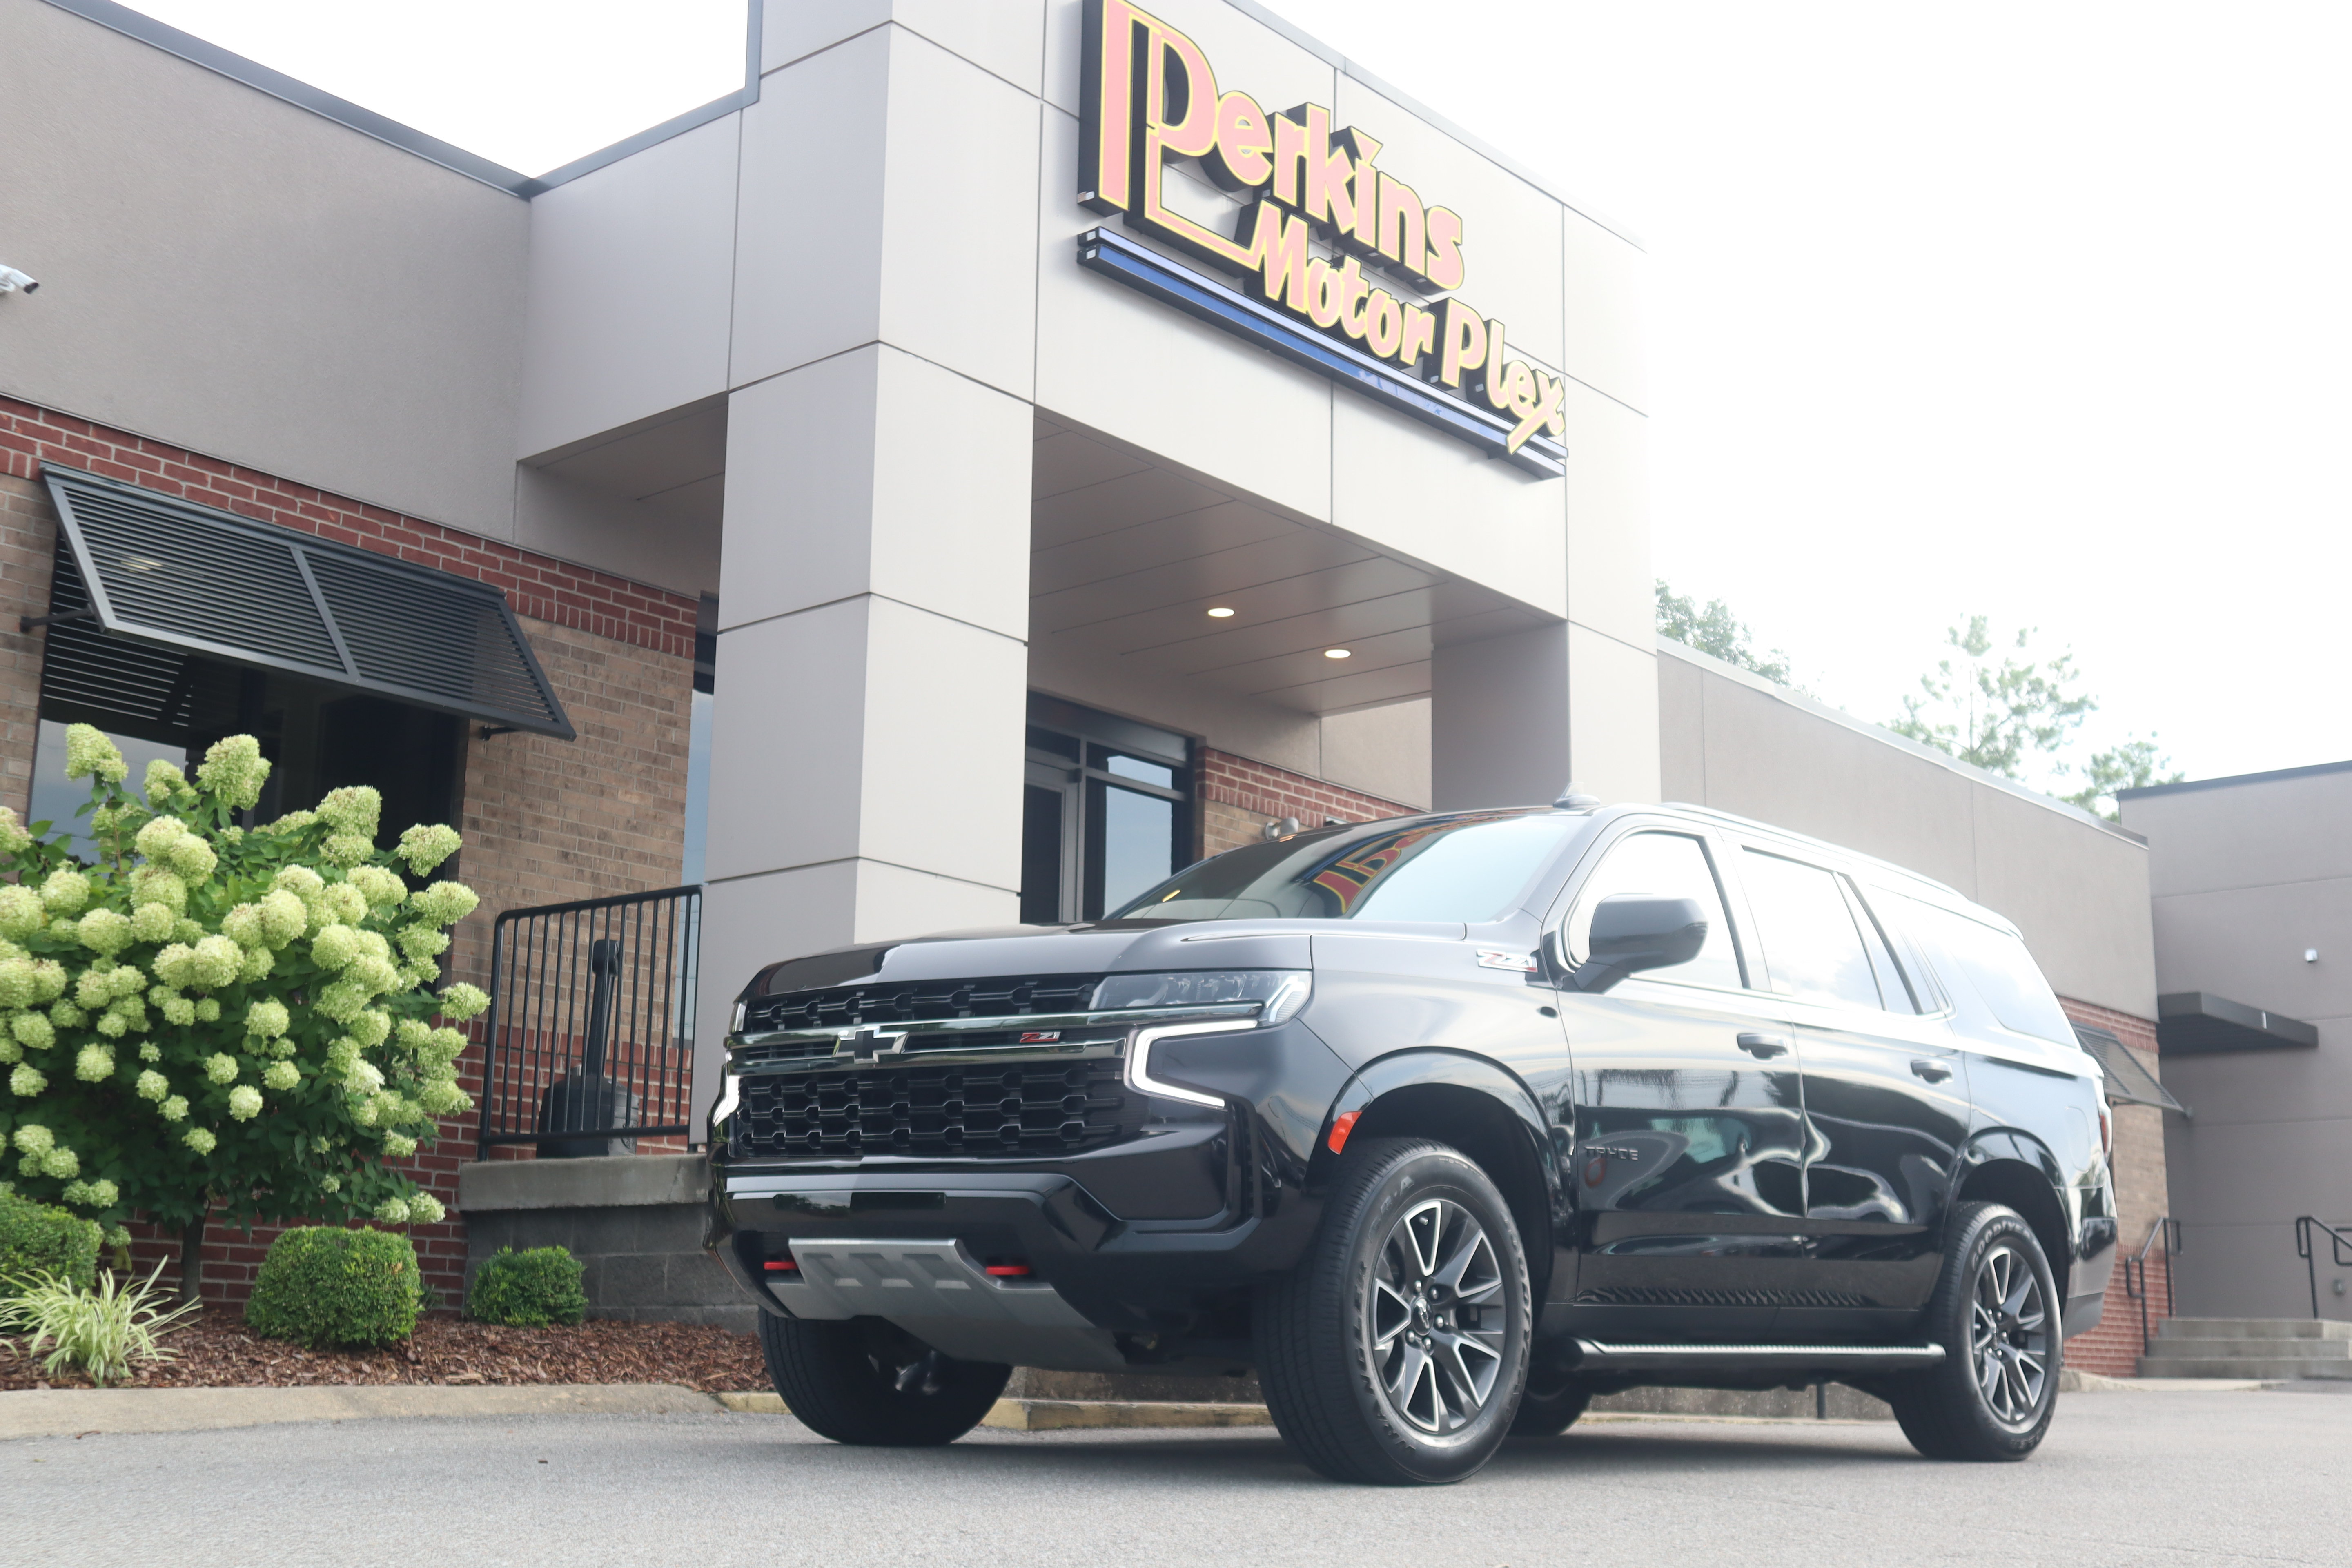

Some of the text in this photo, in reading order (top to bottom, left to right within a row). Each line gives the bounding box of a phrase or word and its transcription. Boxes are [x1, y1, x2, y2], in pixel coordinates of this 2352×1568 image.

[1098, 0, 1464, 292] Perkins
[1249, 198, 1566, 454] Motor Plex
[1020, 1031, 1061, 1043] Z71
[1584, 1146, 1638, 1160] TAHOE
